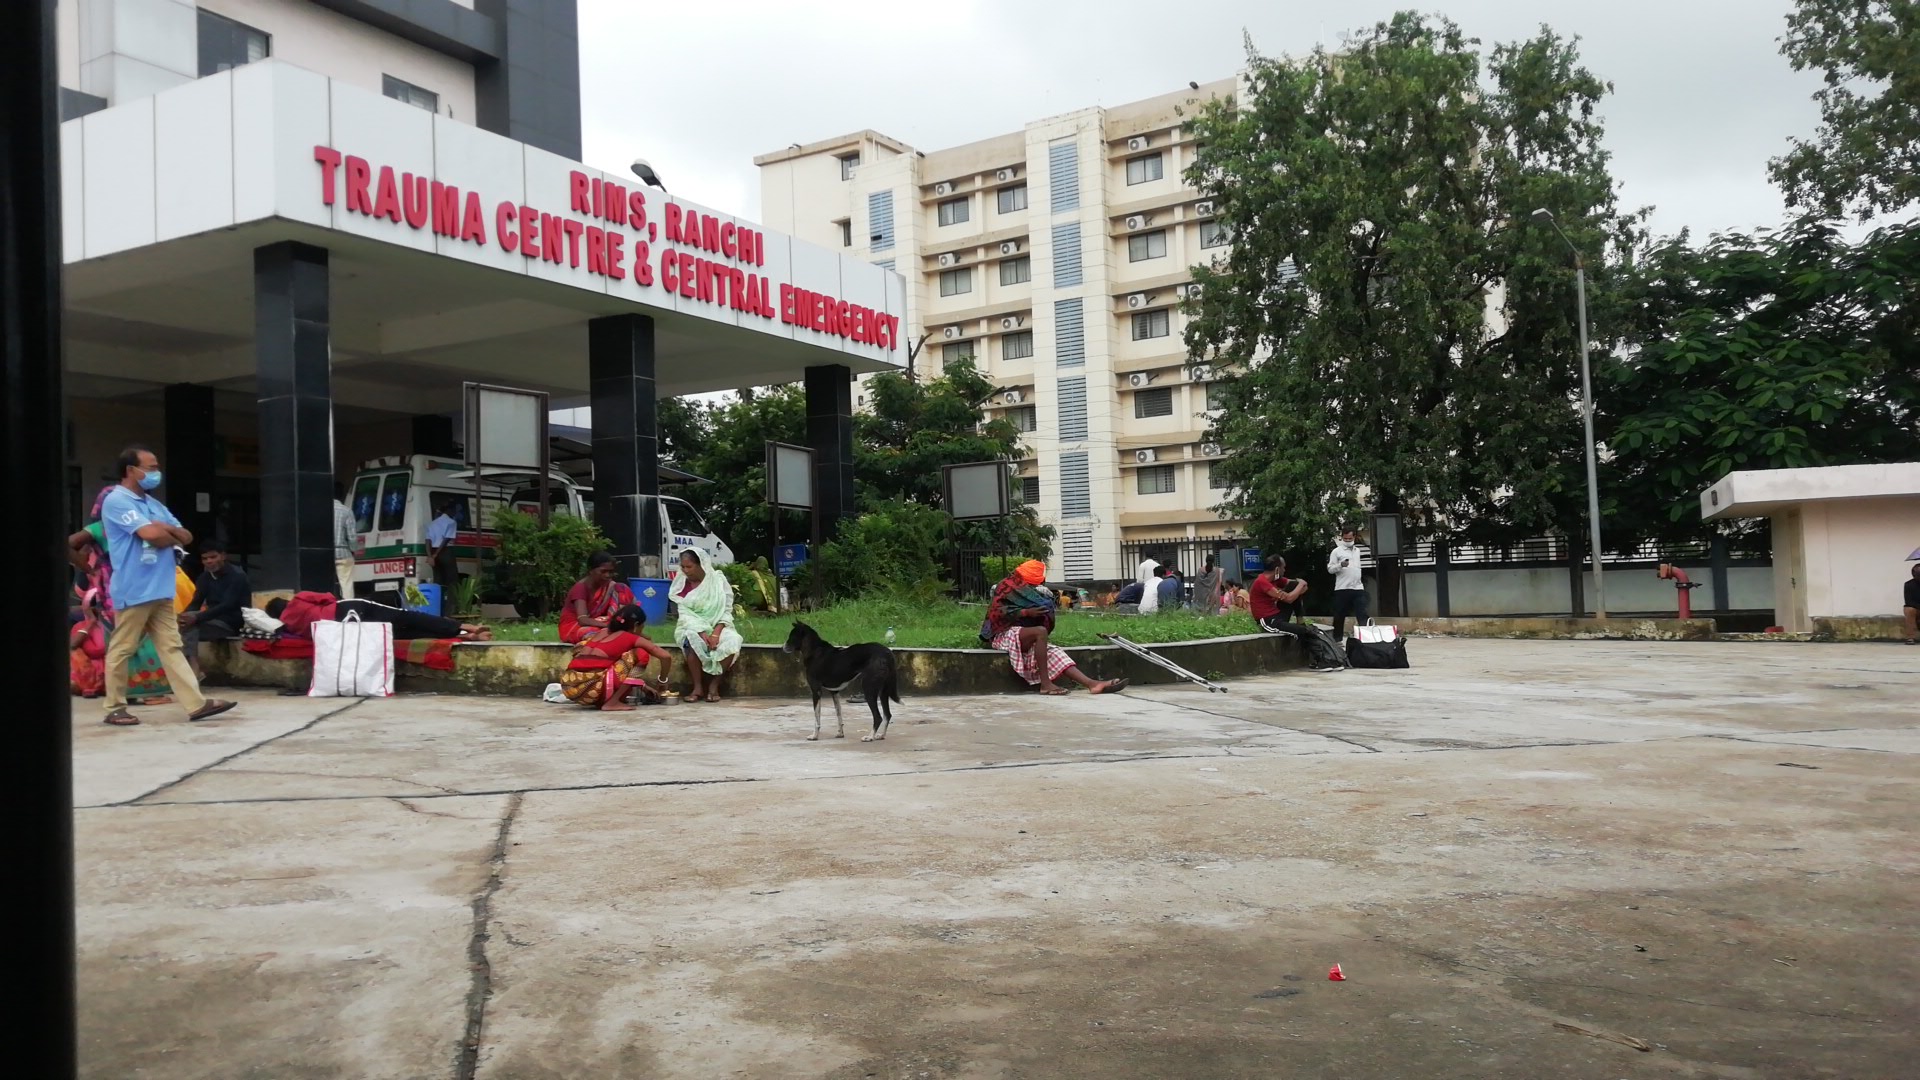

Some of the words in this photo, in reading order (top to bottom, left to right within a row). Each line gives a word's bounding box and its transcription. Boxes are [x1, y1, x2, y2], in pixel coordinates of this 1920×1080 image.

[314, 145, 487, 245] TRAUMA
[496, 201, 627, 280] CENTRE
[634, 240, 655, 287] &
[661, 248, 776, 319] CENTRAL
[780, 282, 899, 350] EMERGENCY
[570, 170, 658, 243] RIMS,
[665, 202, 765, 267] RANCHI
[674, 536, 694, 546] MAA
